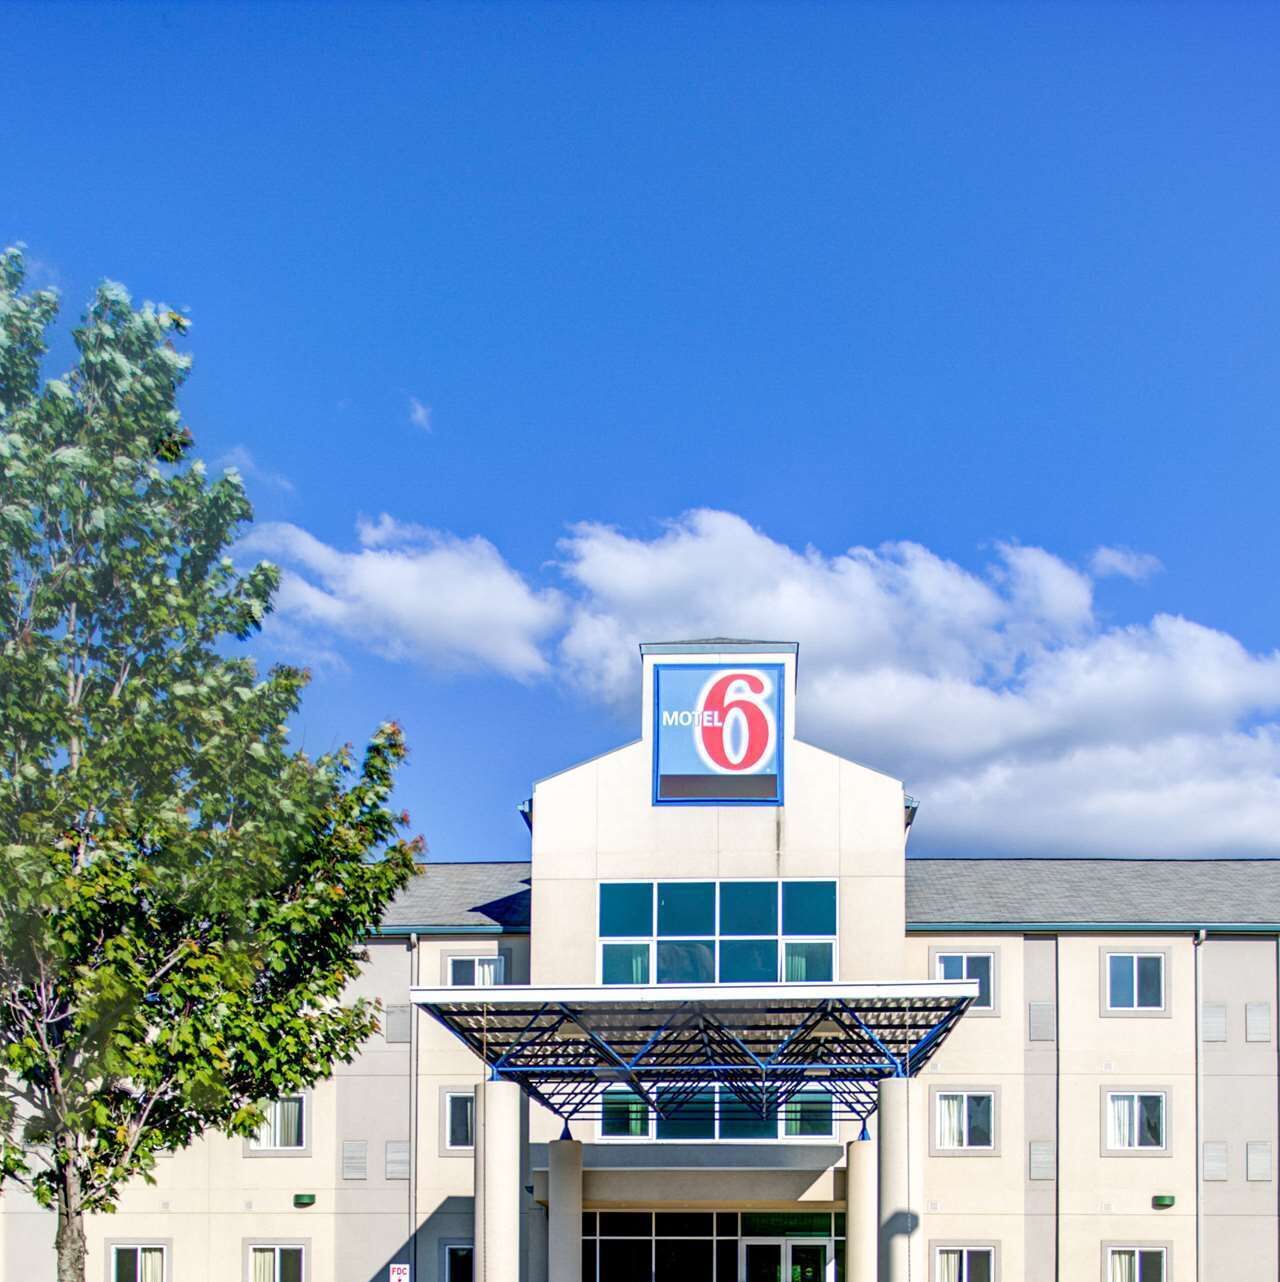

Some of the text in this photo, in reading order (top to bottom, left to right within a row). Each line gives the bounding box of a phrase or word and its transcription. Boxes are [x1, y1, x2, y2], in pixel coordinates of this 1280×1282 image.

[662, 672, 770, 771] MOTEL 6
[391, 1267, 407, 1276] FDC
